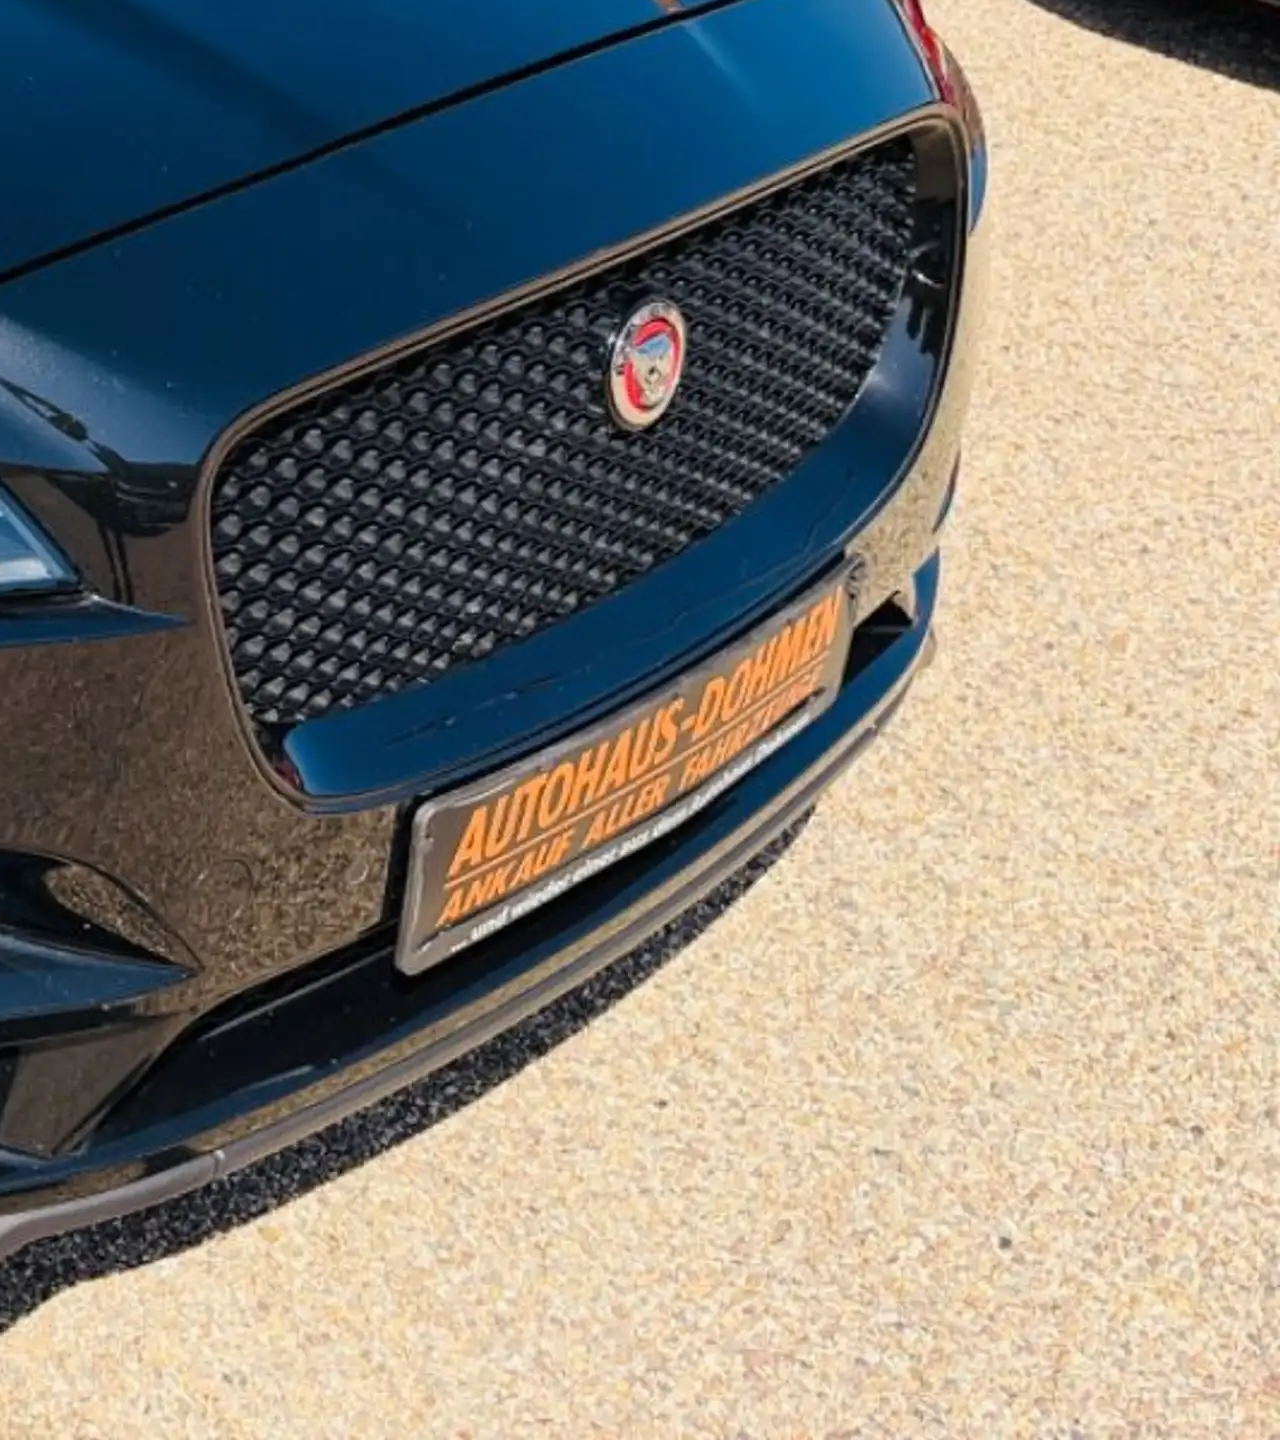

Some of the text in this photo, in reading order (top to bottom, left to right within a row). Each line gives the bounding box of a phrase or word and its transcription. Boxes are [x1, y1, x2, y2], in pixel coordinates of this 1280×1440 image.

[448, 585, 842, 880] AUTOHAUS-DOHMEN
[435, 826, 575, 928] ANKAUF
[581, 772, 671, 851] ALLER
